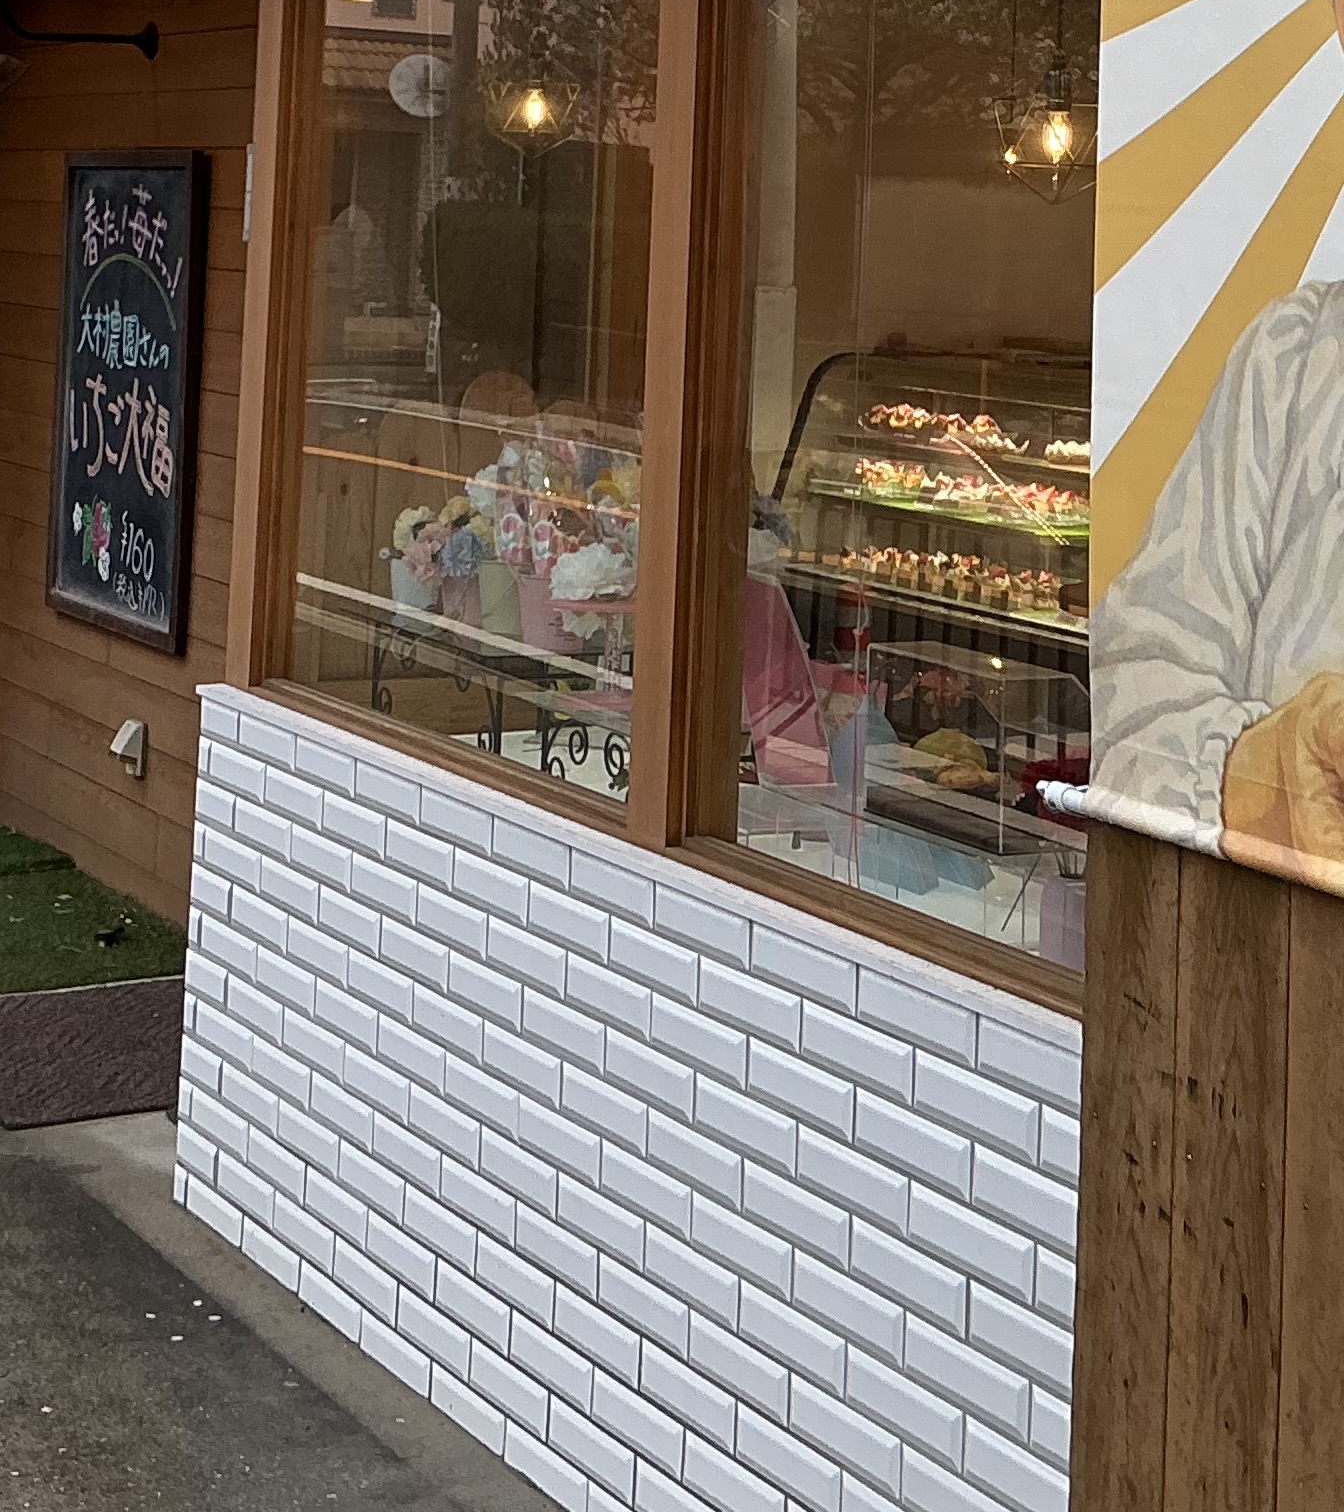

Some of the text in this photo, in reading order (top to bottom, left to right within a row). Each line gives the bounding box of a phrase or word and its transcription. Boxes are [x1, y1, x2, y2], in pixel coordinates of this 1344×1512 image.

[69, 372, 174, 500] いちご大福
